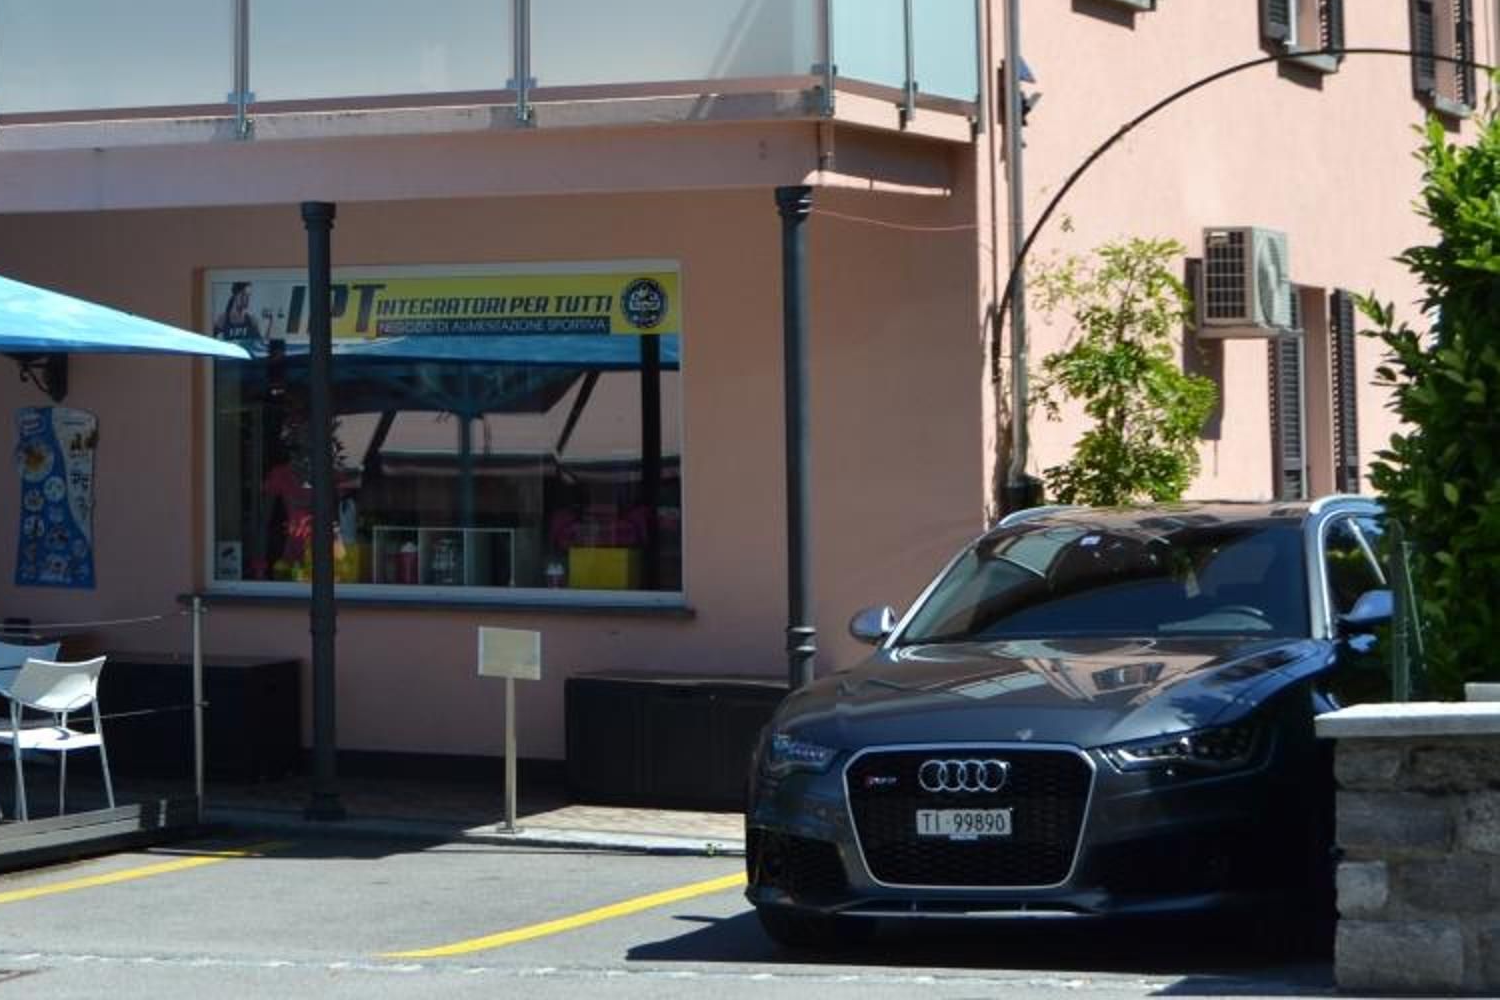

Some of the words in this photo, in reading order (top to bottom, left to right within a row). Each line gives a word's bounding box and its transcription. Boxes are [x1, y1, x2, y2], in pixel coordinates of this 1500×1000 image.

[376, 297, 507, 316] INTEGRATORI
[508, 296, 549, 314] PER
[553, 295, 613, 313] TUTTI
[922, 813, 940, 831] TI
[953, 813, 1005, 832] 99890
